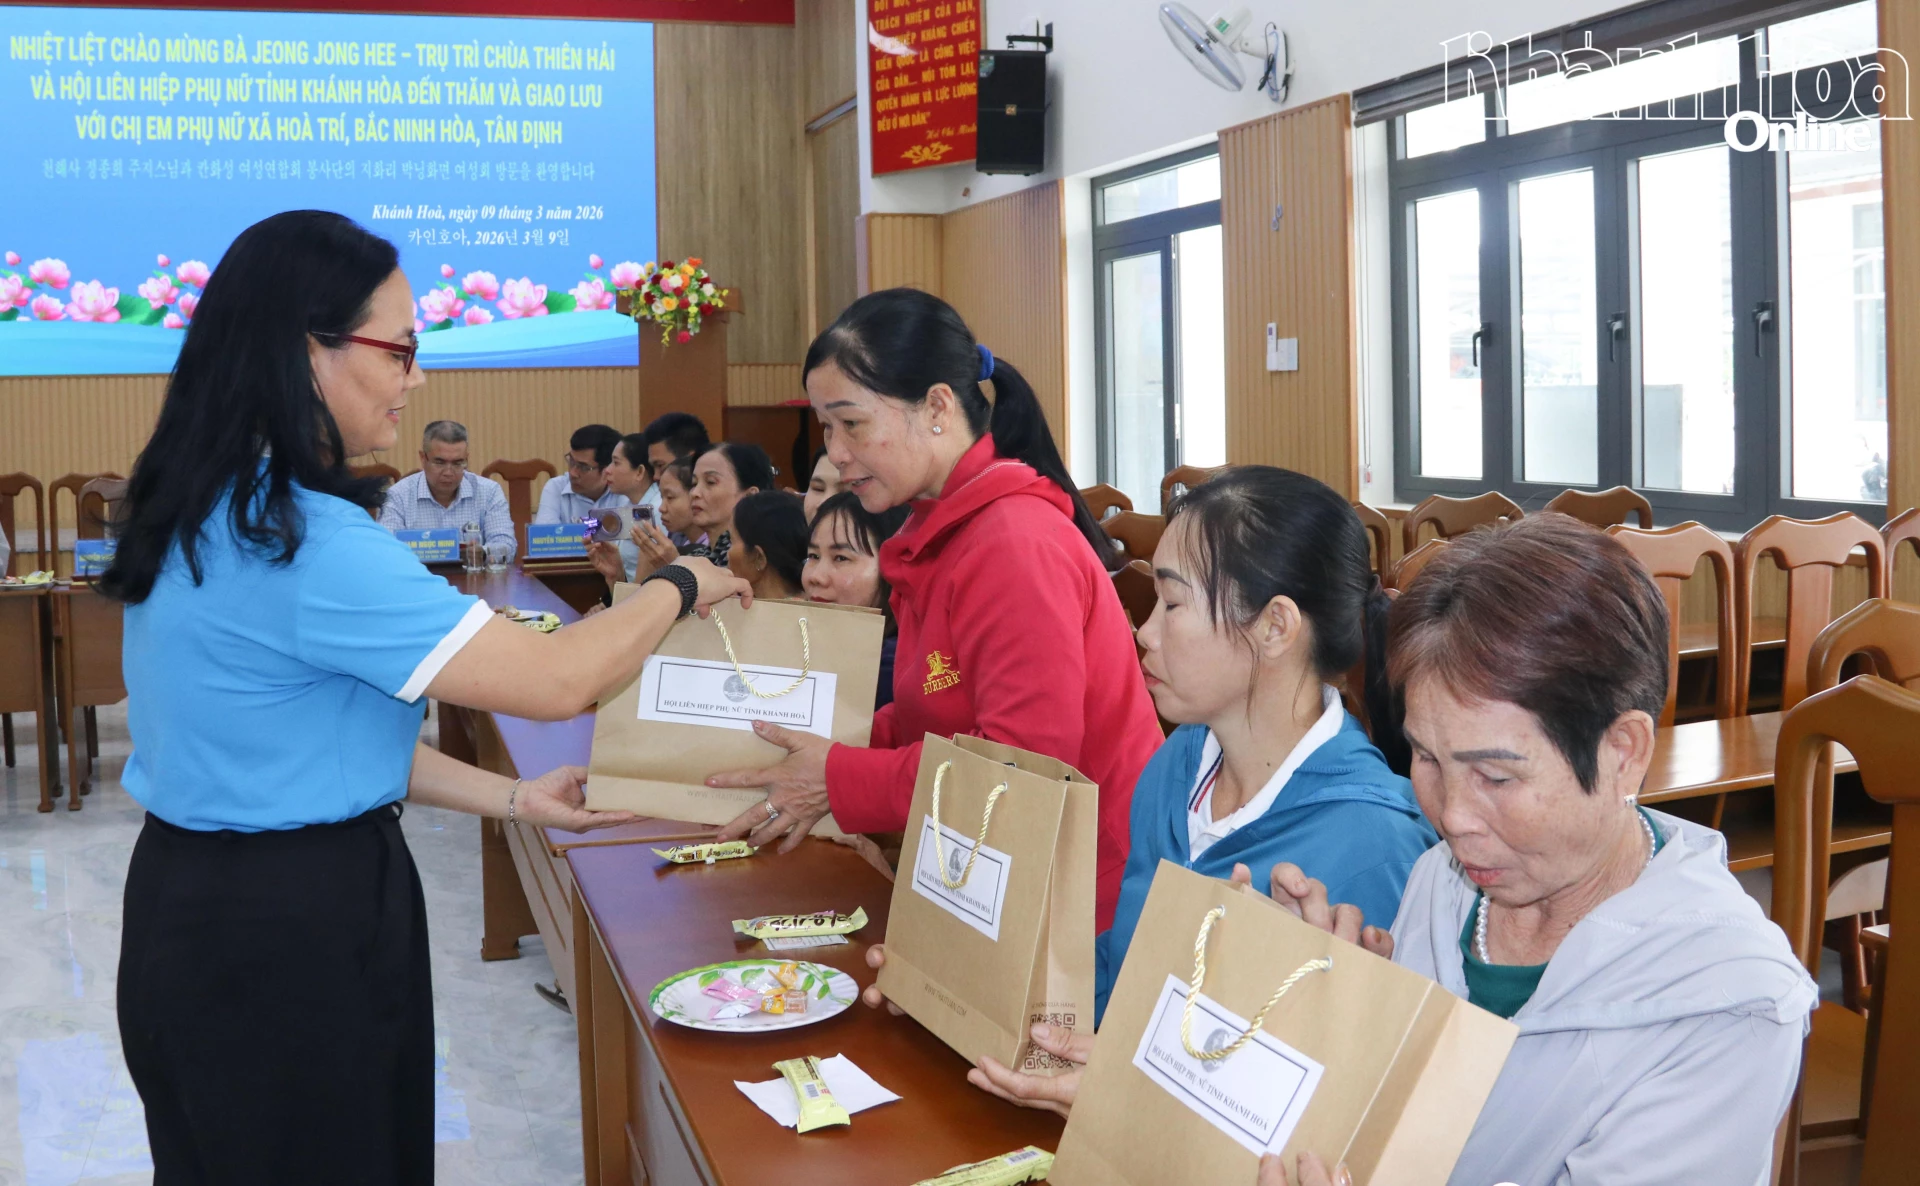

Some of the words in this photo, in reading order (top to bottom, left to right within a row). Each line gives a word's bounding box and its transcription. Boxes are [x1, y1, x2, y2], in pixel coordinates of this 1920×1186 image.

[10, 30, 64, 66] NHIỆT
[69, 31, 106, 67] LIỆT
[111, 32, 160, 63] CHÀO
[166, 33, 219, 64] MỪNG
[224, 34, 247, 64] BÀ
[252, 40, 308, 65] JEONG
[313, 41, 359, 66] JONG
[364, 42, 396, 66] HEE
[416, 44, 448, 72] TRỤ
[453, 39, 479, 68] TRÌ
[484, 40, 529, 69] CHÙA
[534, 42, 582, 70] THIÊN
[587, 41, 615, 71] HẢI
[30, 69, 55, 100] VÀ
[60, 70, 91, 106] HỘI
[97, 71, 134, 101] LIÊN
[140, 72, 180, 107] HIỆP
[185, 77, 221, 107] PHỤ
[226, 73, 252, 102] NỮ
[255, 71, 296, 103] TỈNH
[303, 74, 362, 103] KHÁNH
[367, 75, 403, 104] HÒA
[407, 74, 441, 105] ĐẾN
[445, 77, 494, 106] THĂM
[499, 78, 521, 106] VÀ
[526, 83, 565, 107] GIAO
[570, 84, 602, 108] LƯU
[75, 109, 106, 140] VỚI
[111, 115, 141, 145] CHỊ
[147, 116, 172, 140] EM
[177, 116, 213, 146] PHỤ
[218, 111, 245, 141] NỮ
[248, 112, 272, 141] XÃ
[277, 112, 314, 142] HOÀ
[317, 112, 349, 146] TRÍ,
[355, 111, 389, 142] BẮC
[394, 118, 435, 143] NINH
[440, 113, 480, 148] HÒA,
[485, 115, 517, 144] TÂN
[522, 120, 562, 149] ĐỊNH
[85, 158, 123, 179] 정종희
[128, 158, 192, 179] 주지스님과
[239, 159, 301, 180] 여성연합회
[306, 159, 355, 180] 봉사단의
[360, 160, 397, 180] 지화리
[454, 161, 491, 181] 여성회
[495, 161, 531, 182] 방문을
[535, 161, 596, 182] 환영합니다
[372, 204, 412, 219] Khánh
[417, 205, 446, 221] Hoà,
[449, 206, 478, 223] ngày
[481, 205, 496, 219] 09
[498, 204, 532, 223] tháng
[535, 206, 543, 219] 3
[546, 206, 572, 219] năm
[575, 206, 603, 220] 2026
[407, 228, 470, 247] 카인호아,
[475, 229, 518, 246] 2026년
[523, 229, 544, 246] 3월
[549, 229, 570, 246] 9일
